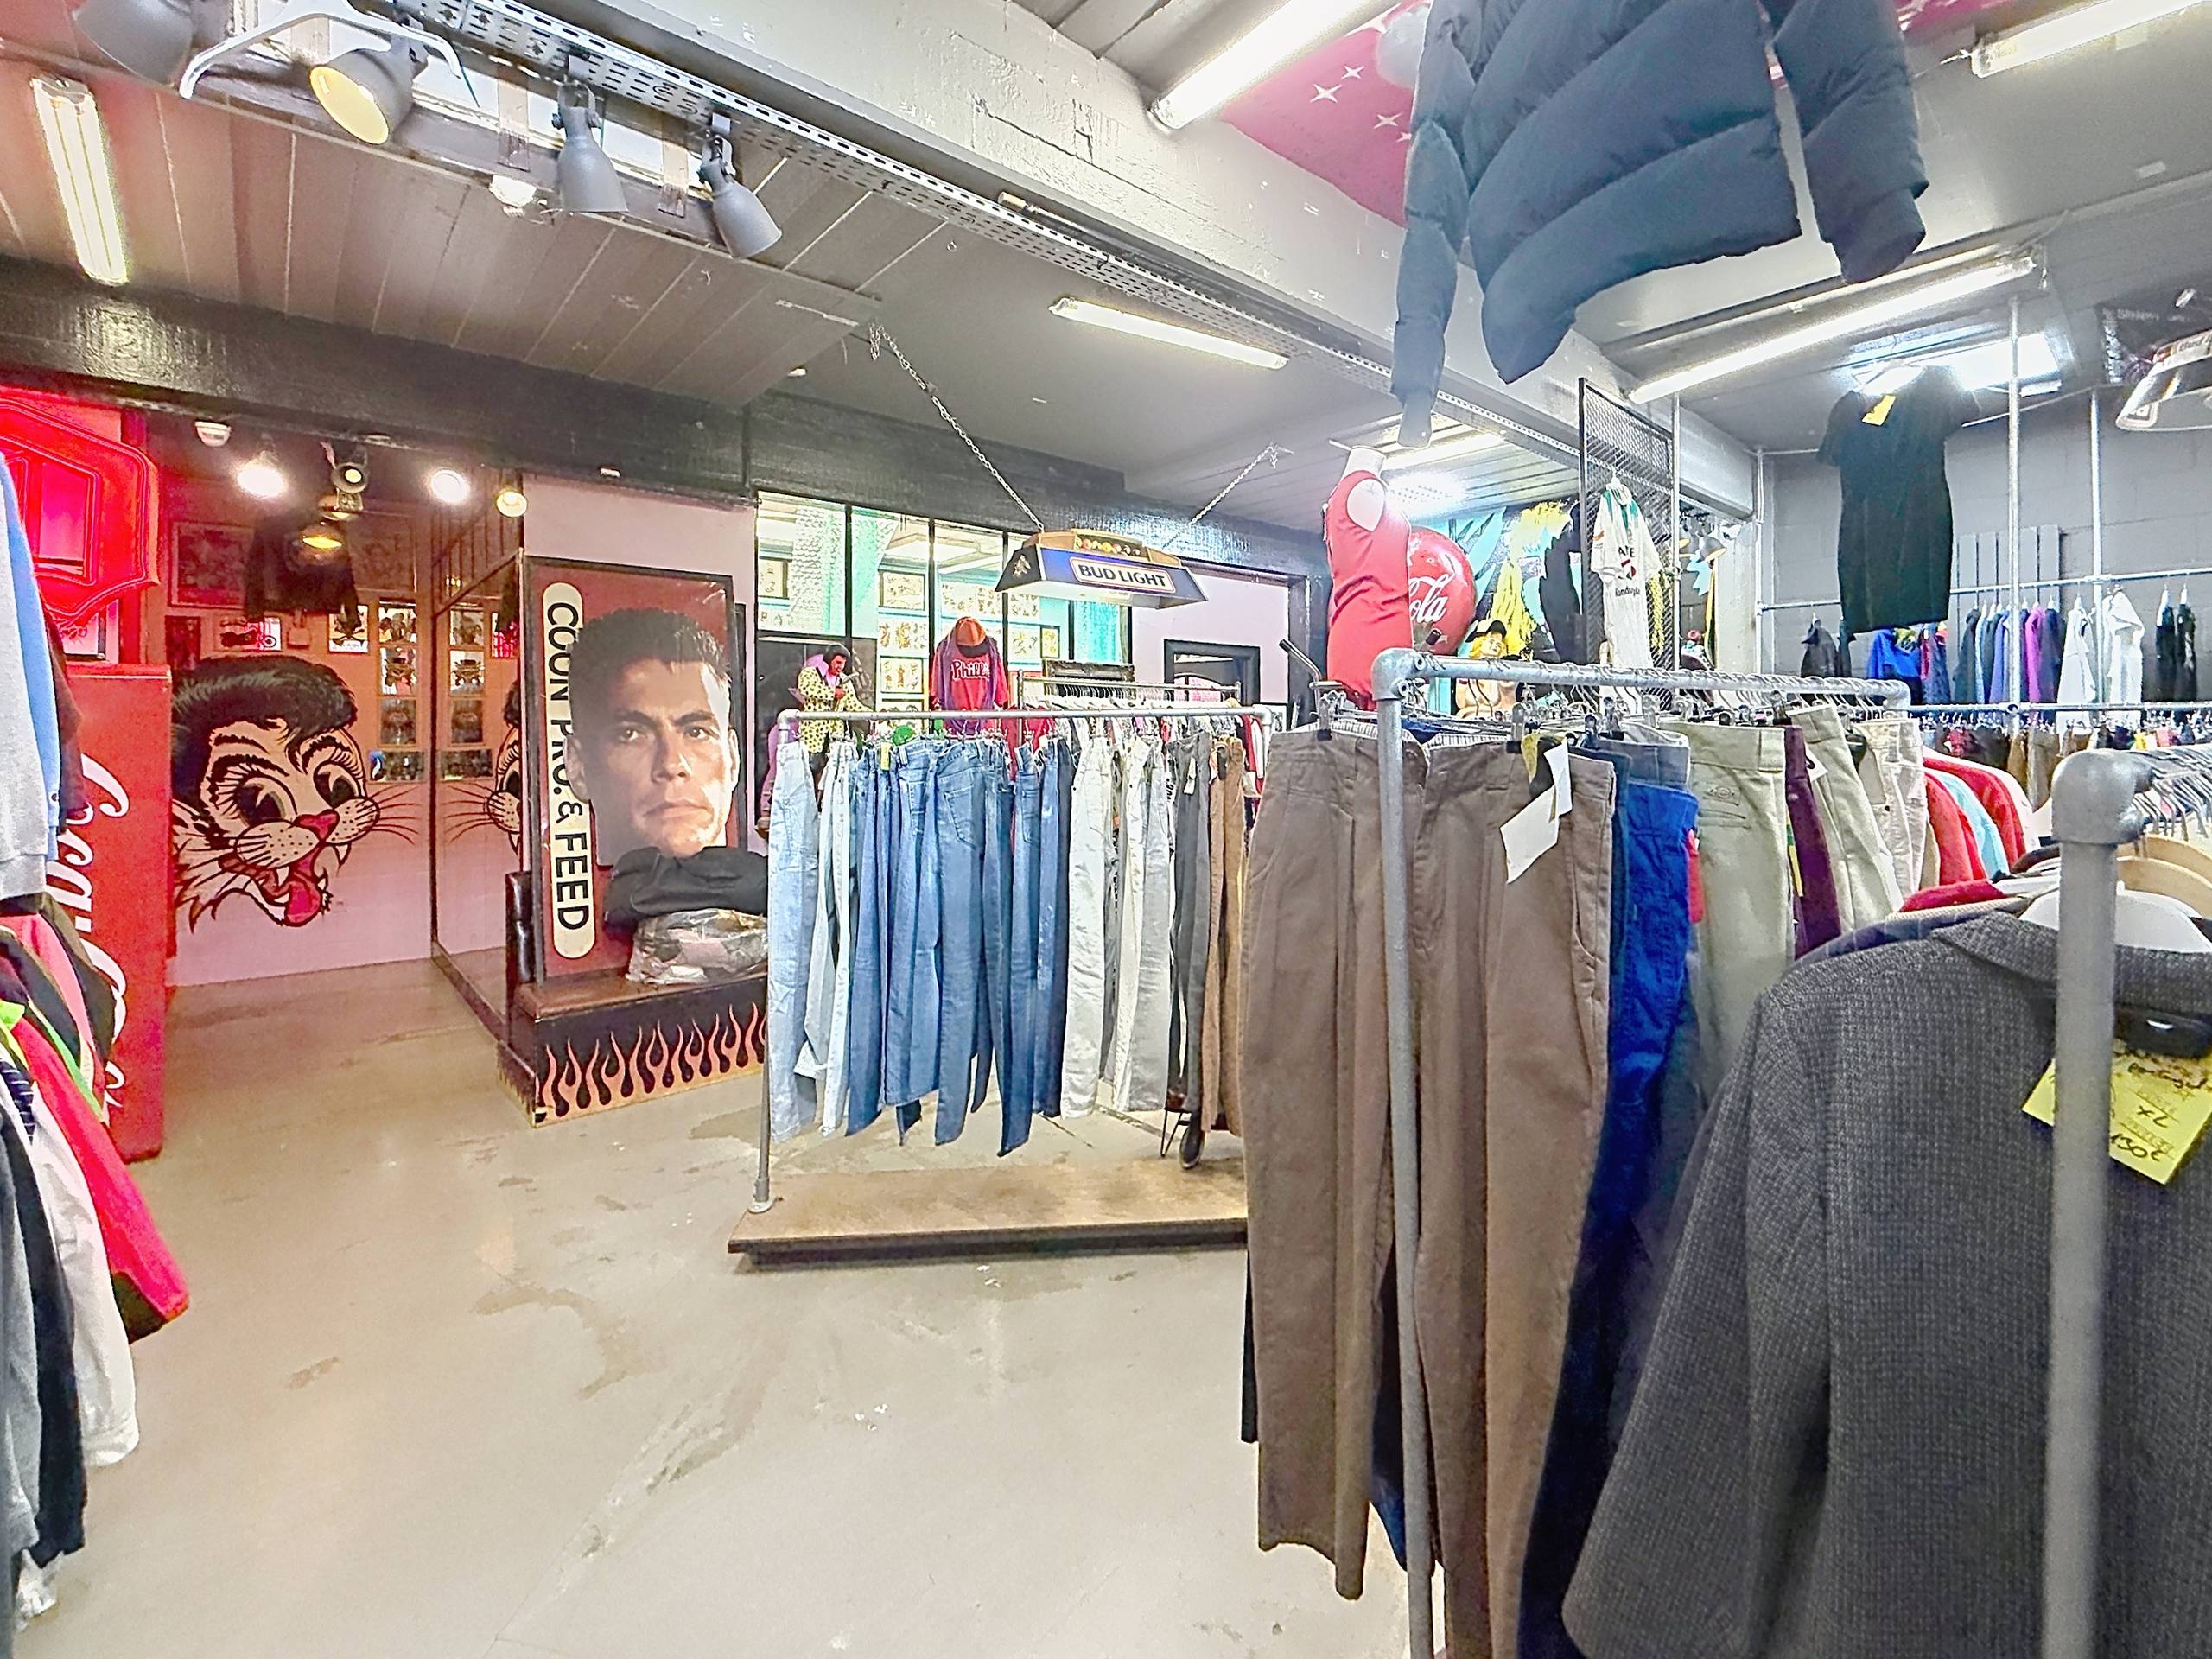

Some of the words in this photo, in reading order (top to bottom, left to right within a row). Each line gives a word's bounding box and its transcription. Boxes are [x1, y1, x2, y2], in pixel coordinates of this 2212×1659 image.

[1077, 563, 1116, 581] BUD
[1118, 570, 1166, 588] LIGHT
[548, 602, 580, 701] COON
[556, 801, 583, 823] &
[555, 833, 589, 931] FEED
